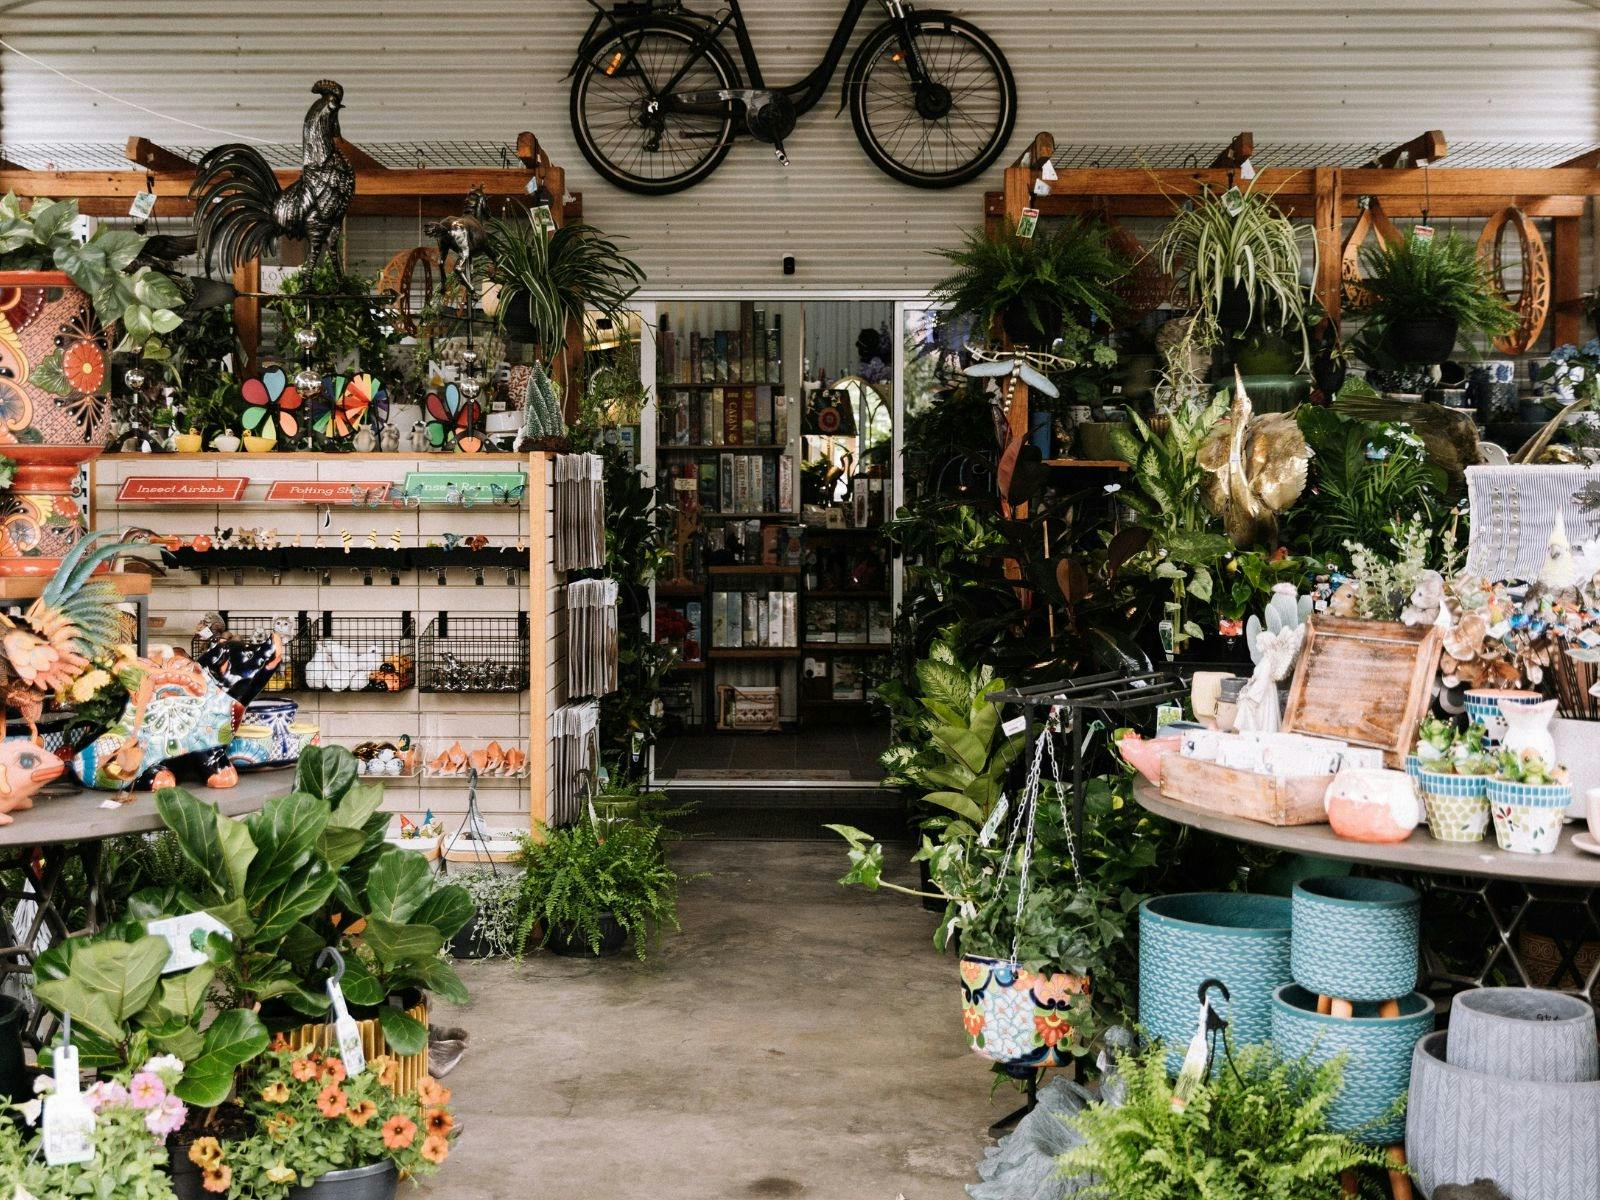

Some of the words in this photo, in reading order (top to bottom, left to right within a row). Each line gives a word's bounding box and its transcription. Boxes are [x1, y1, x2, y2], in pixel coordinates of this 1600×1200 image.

[728, 401, 738, 431] CATAN
[137, 485, 177, 493] Insect
[177, 485, 225, 493] Airbnb
[290, 486, 334, 496] Potting
[336, 486, 369, 494] Shd
